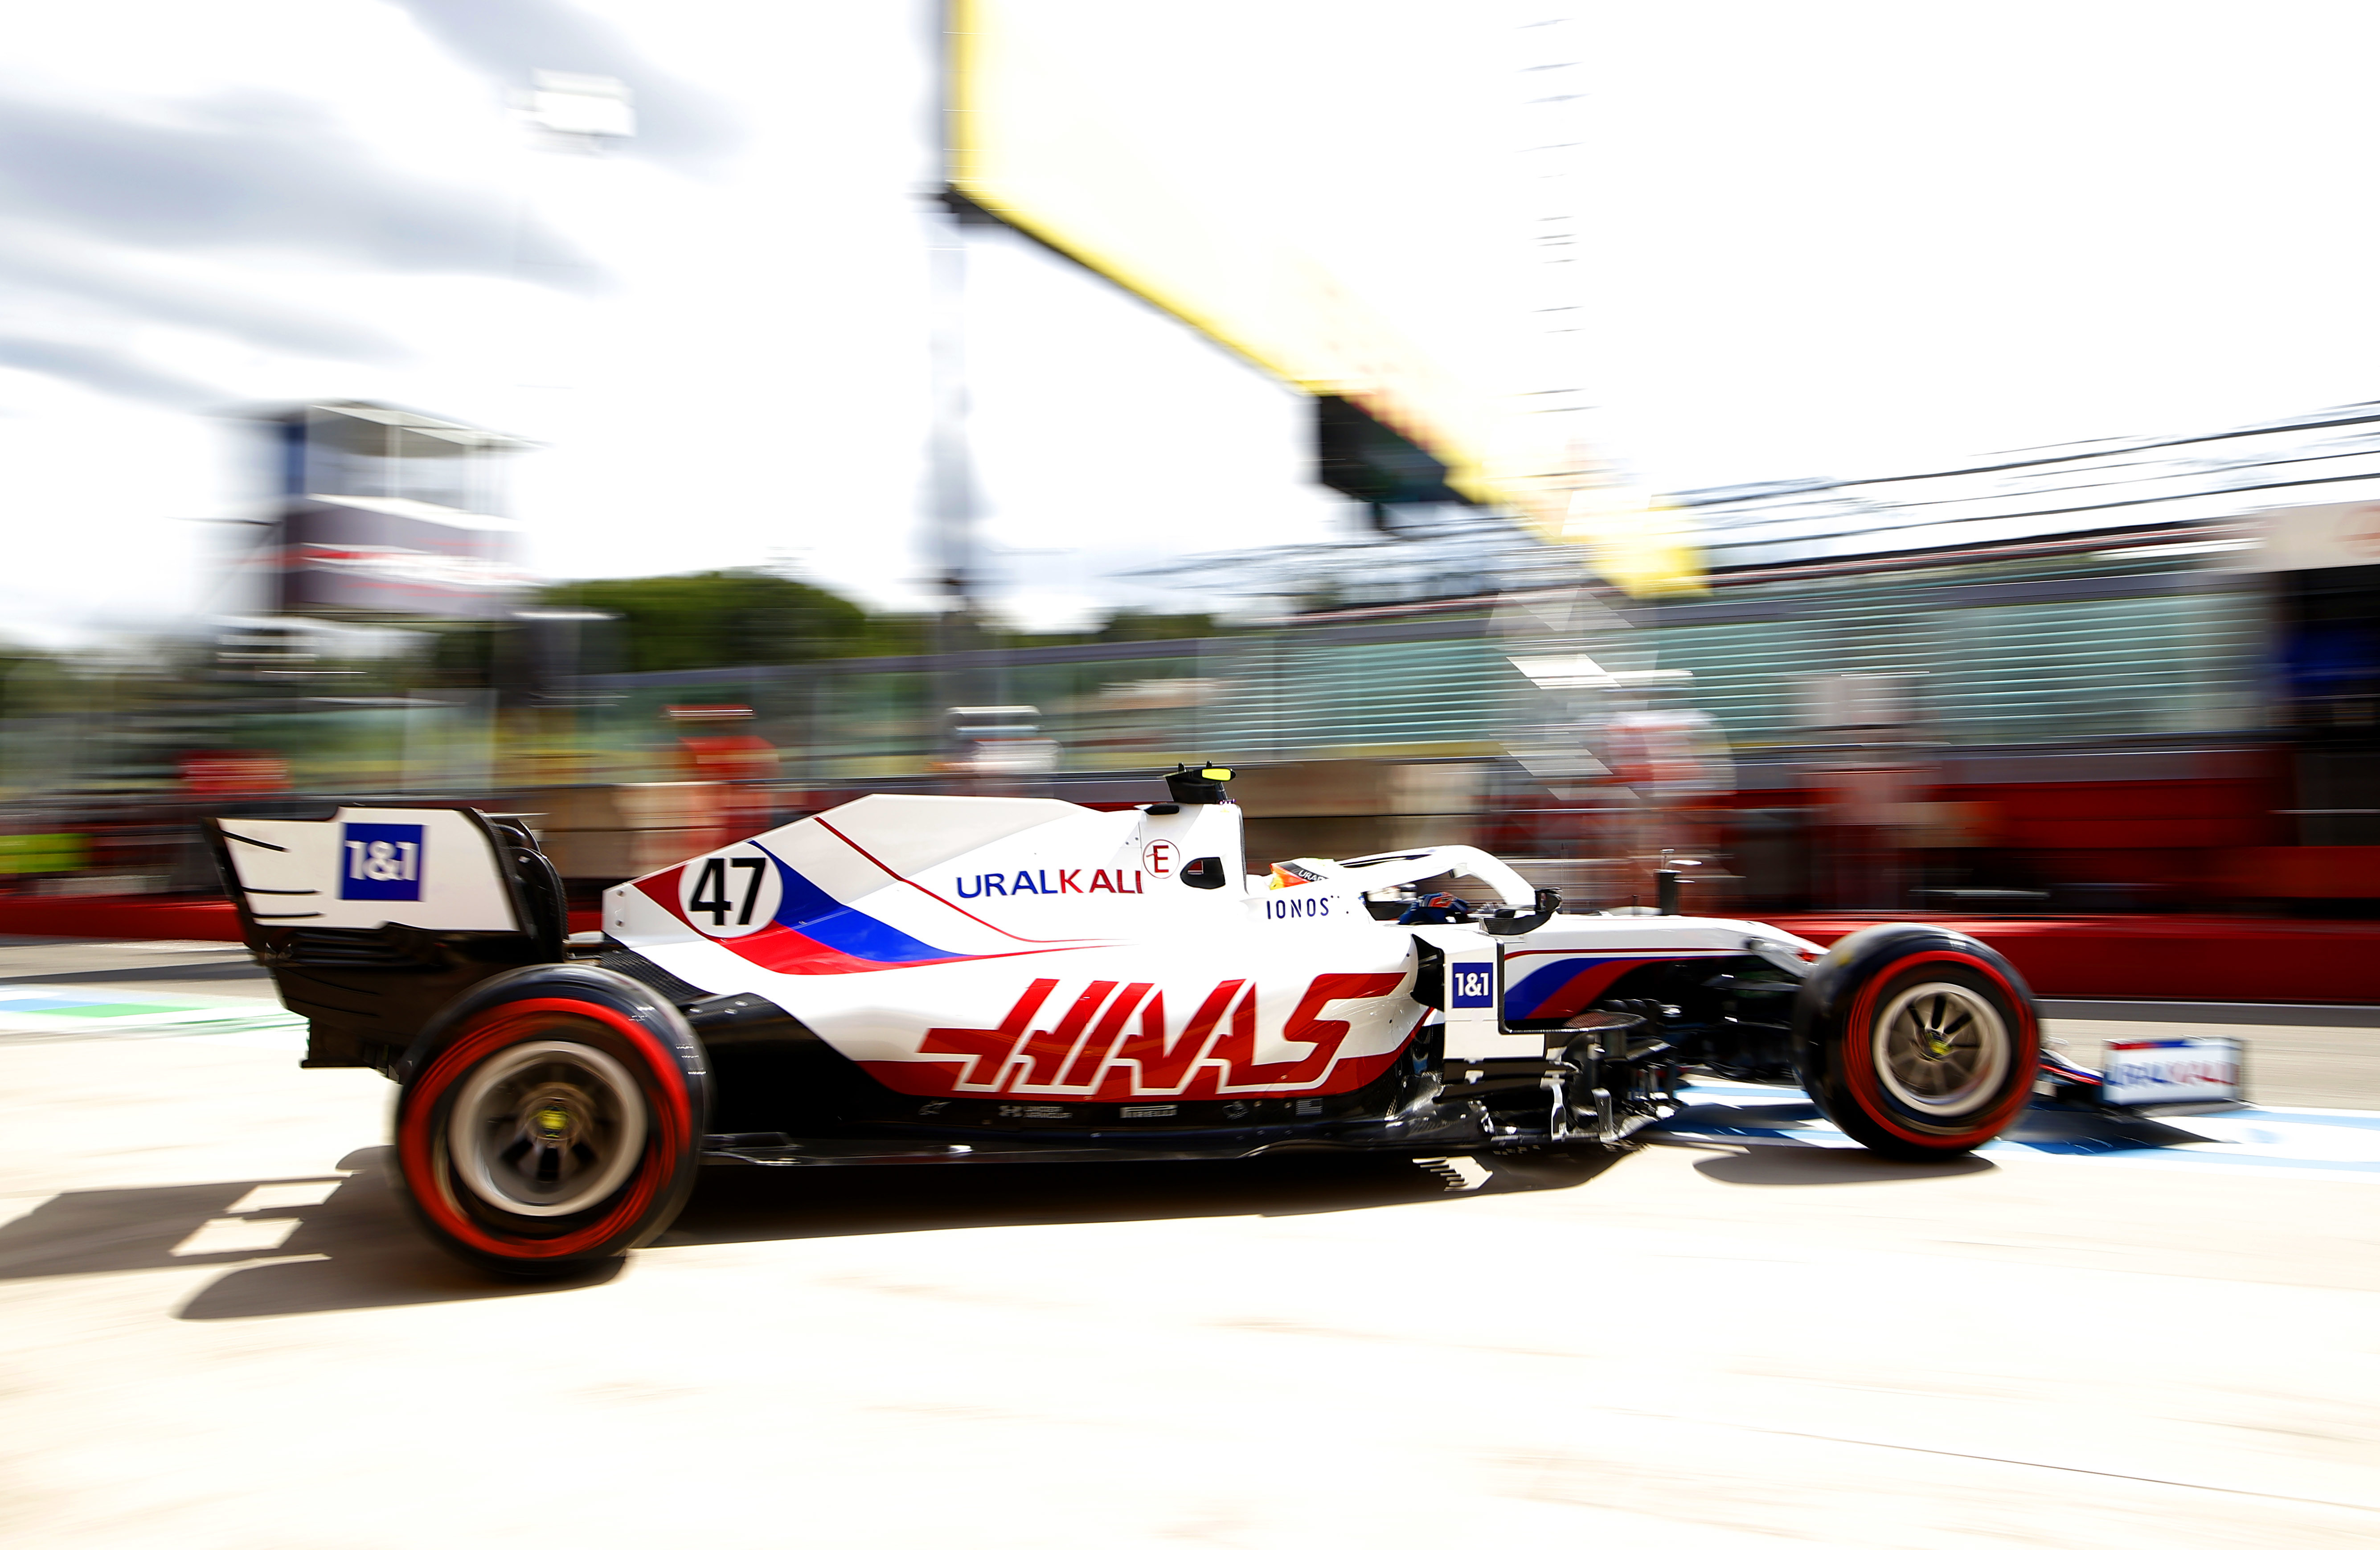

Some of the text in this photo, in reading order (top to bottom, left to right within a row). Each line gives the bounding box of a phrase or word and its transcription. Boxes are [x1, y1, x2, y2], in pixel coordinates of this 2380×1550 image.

[345, 841, 418, 881] 1&1
[1153, 845, 1170, 873] E
[689, 857, 766, 926] 47
[956, 869, 1144, 898] URALKALI
[1266, 898, 1329, 919] IONOS
[1454, 972, 1490, 997] 1&1
[917, 972, 1408, 1093] HAAS
